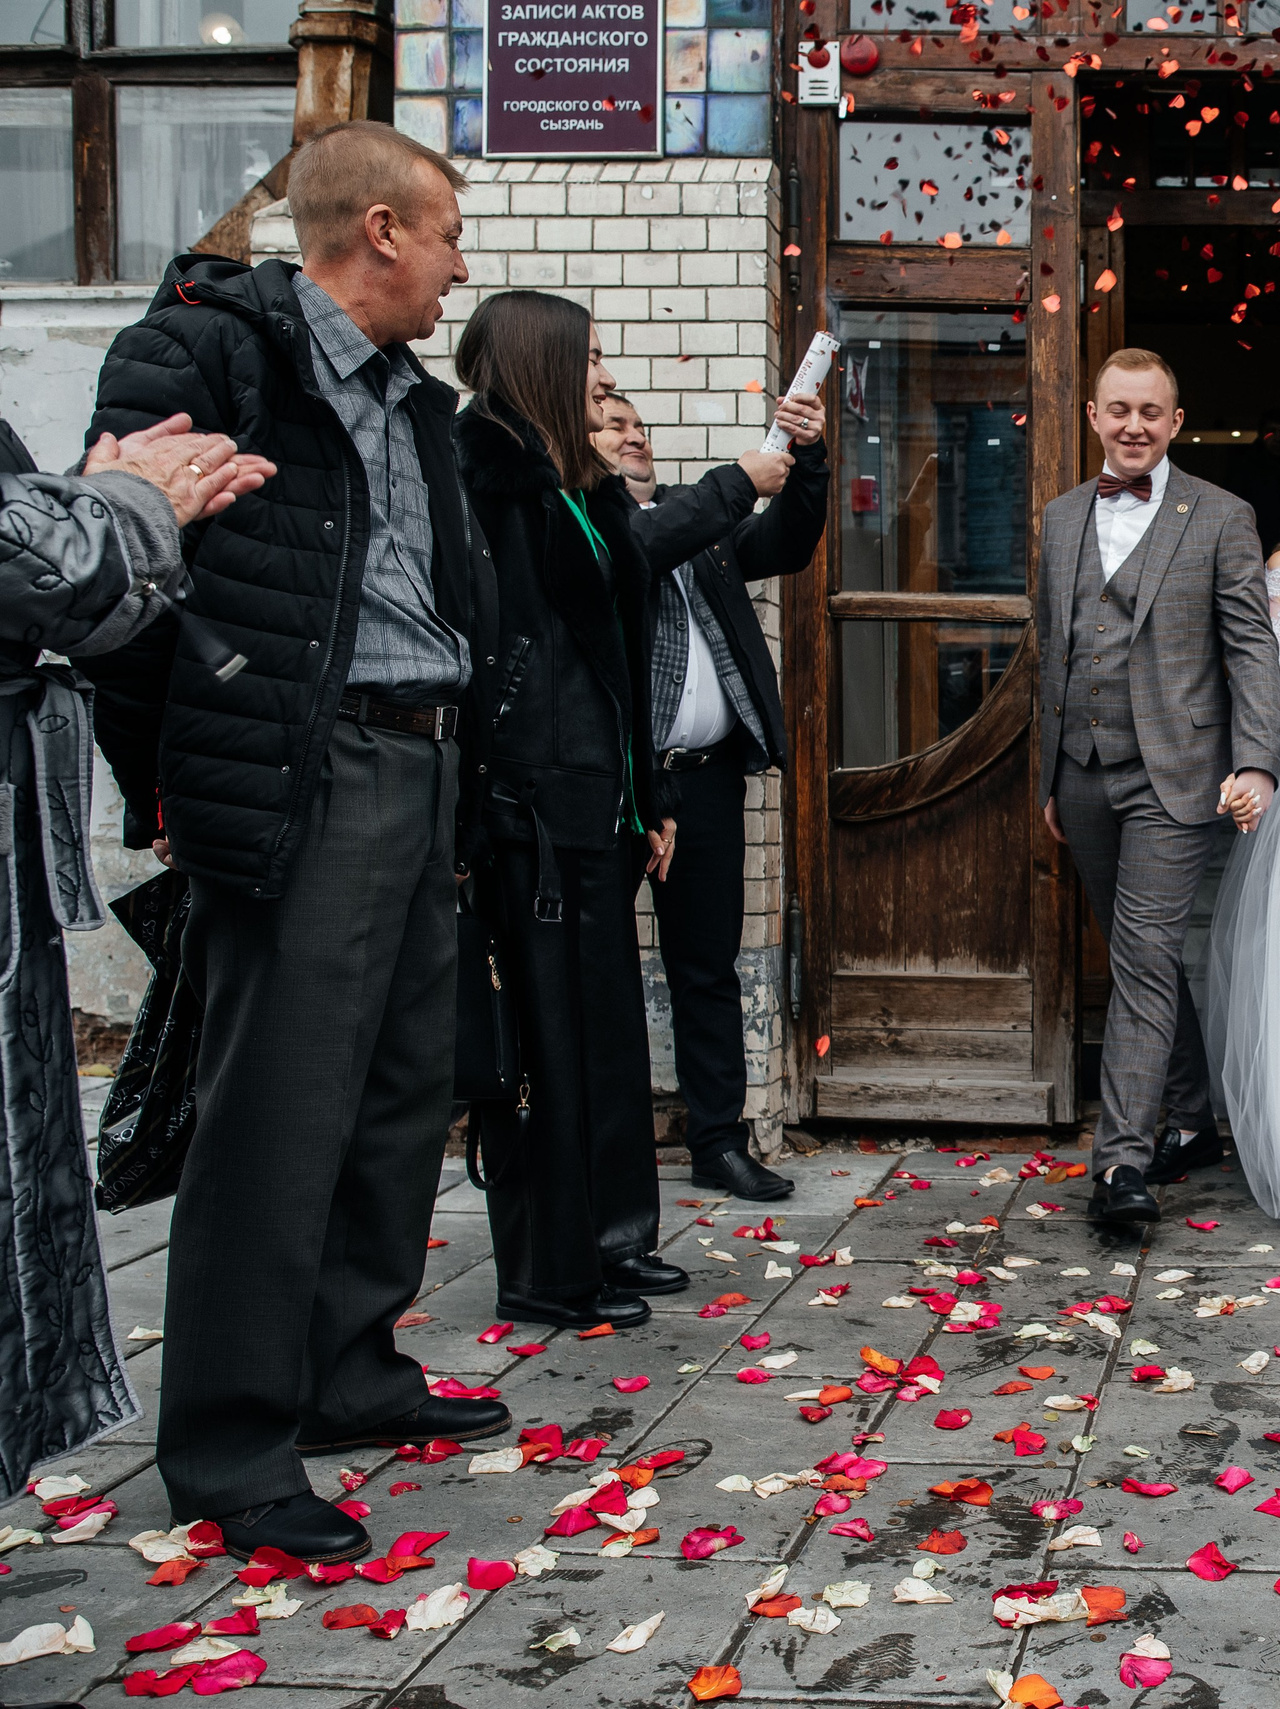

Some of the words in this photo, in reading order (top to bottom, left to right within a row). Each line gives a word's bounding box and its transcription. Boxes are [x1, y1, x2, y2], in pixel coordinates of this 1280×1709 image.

[501, 4, 577, 20] ЗАПИСИ
[581, 4, 645, 20] АКТОВ
[498, 31, 649, 48] ГРАЖДАНСКОГО
[514, 57, 630, 74] СОСТОЯНИЯ
[503, 100, 590, 114] ГОРОДСКОГО
[592, 100, 642, 112] ОУГА
[540, 119, 604, 131] СЫЗРАНЬ
[103, 1160, 147, 1203] STONES
